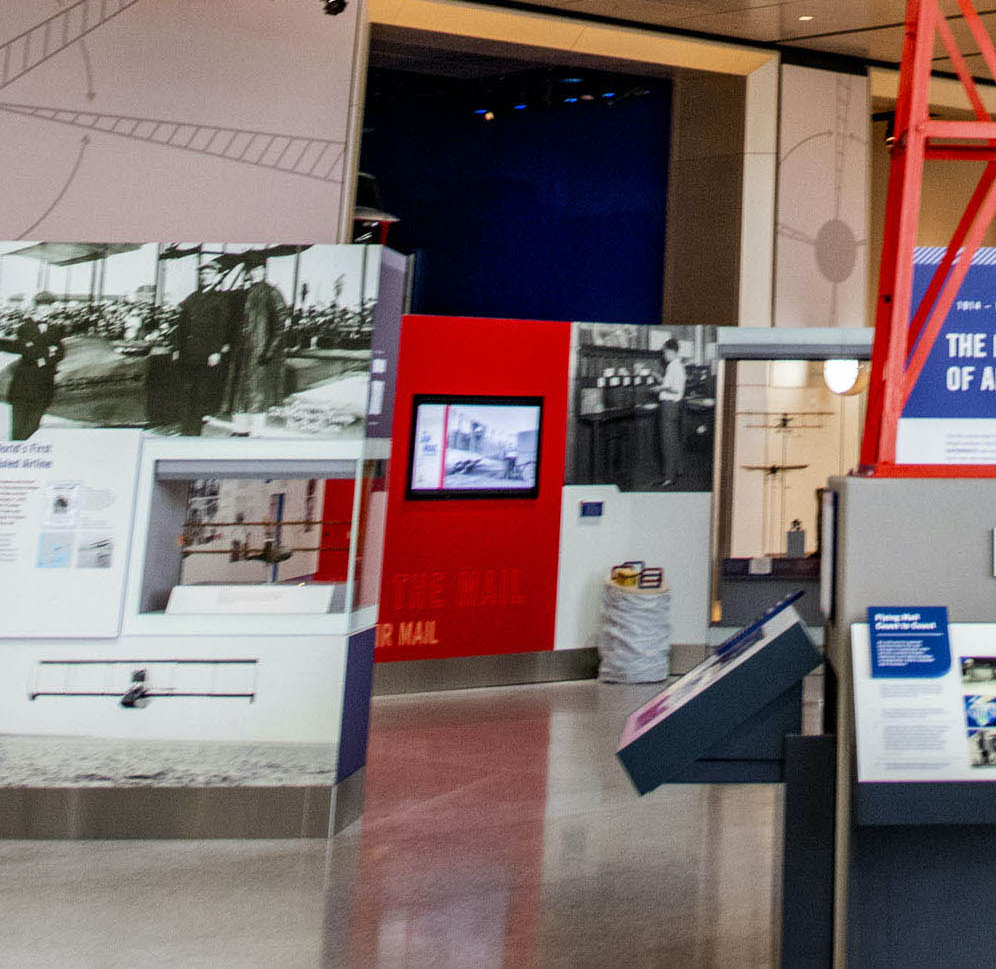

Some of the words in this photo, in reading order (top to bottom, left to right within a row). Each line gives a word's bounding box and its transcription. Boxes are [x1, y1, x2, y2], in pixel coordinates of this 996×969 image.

[946, 333, 987, 359] THE
[946, 366, 975, 391] OF
[456, 568, 529, 607] MAIL
[375, 622, 394, 647] IR
[398, 620, 439, 646] MAIL
